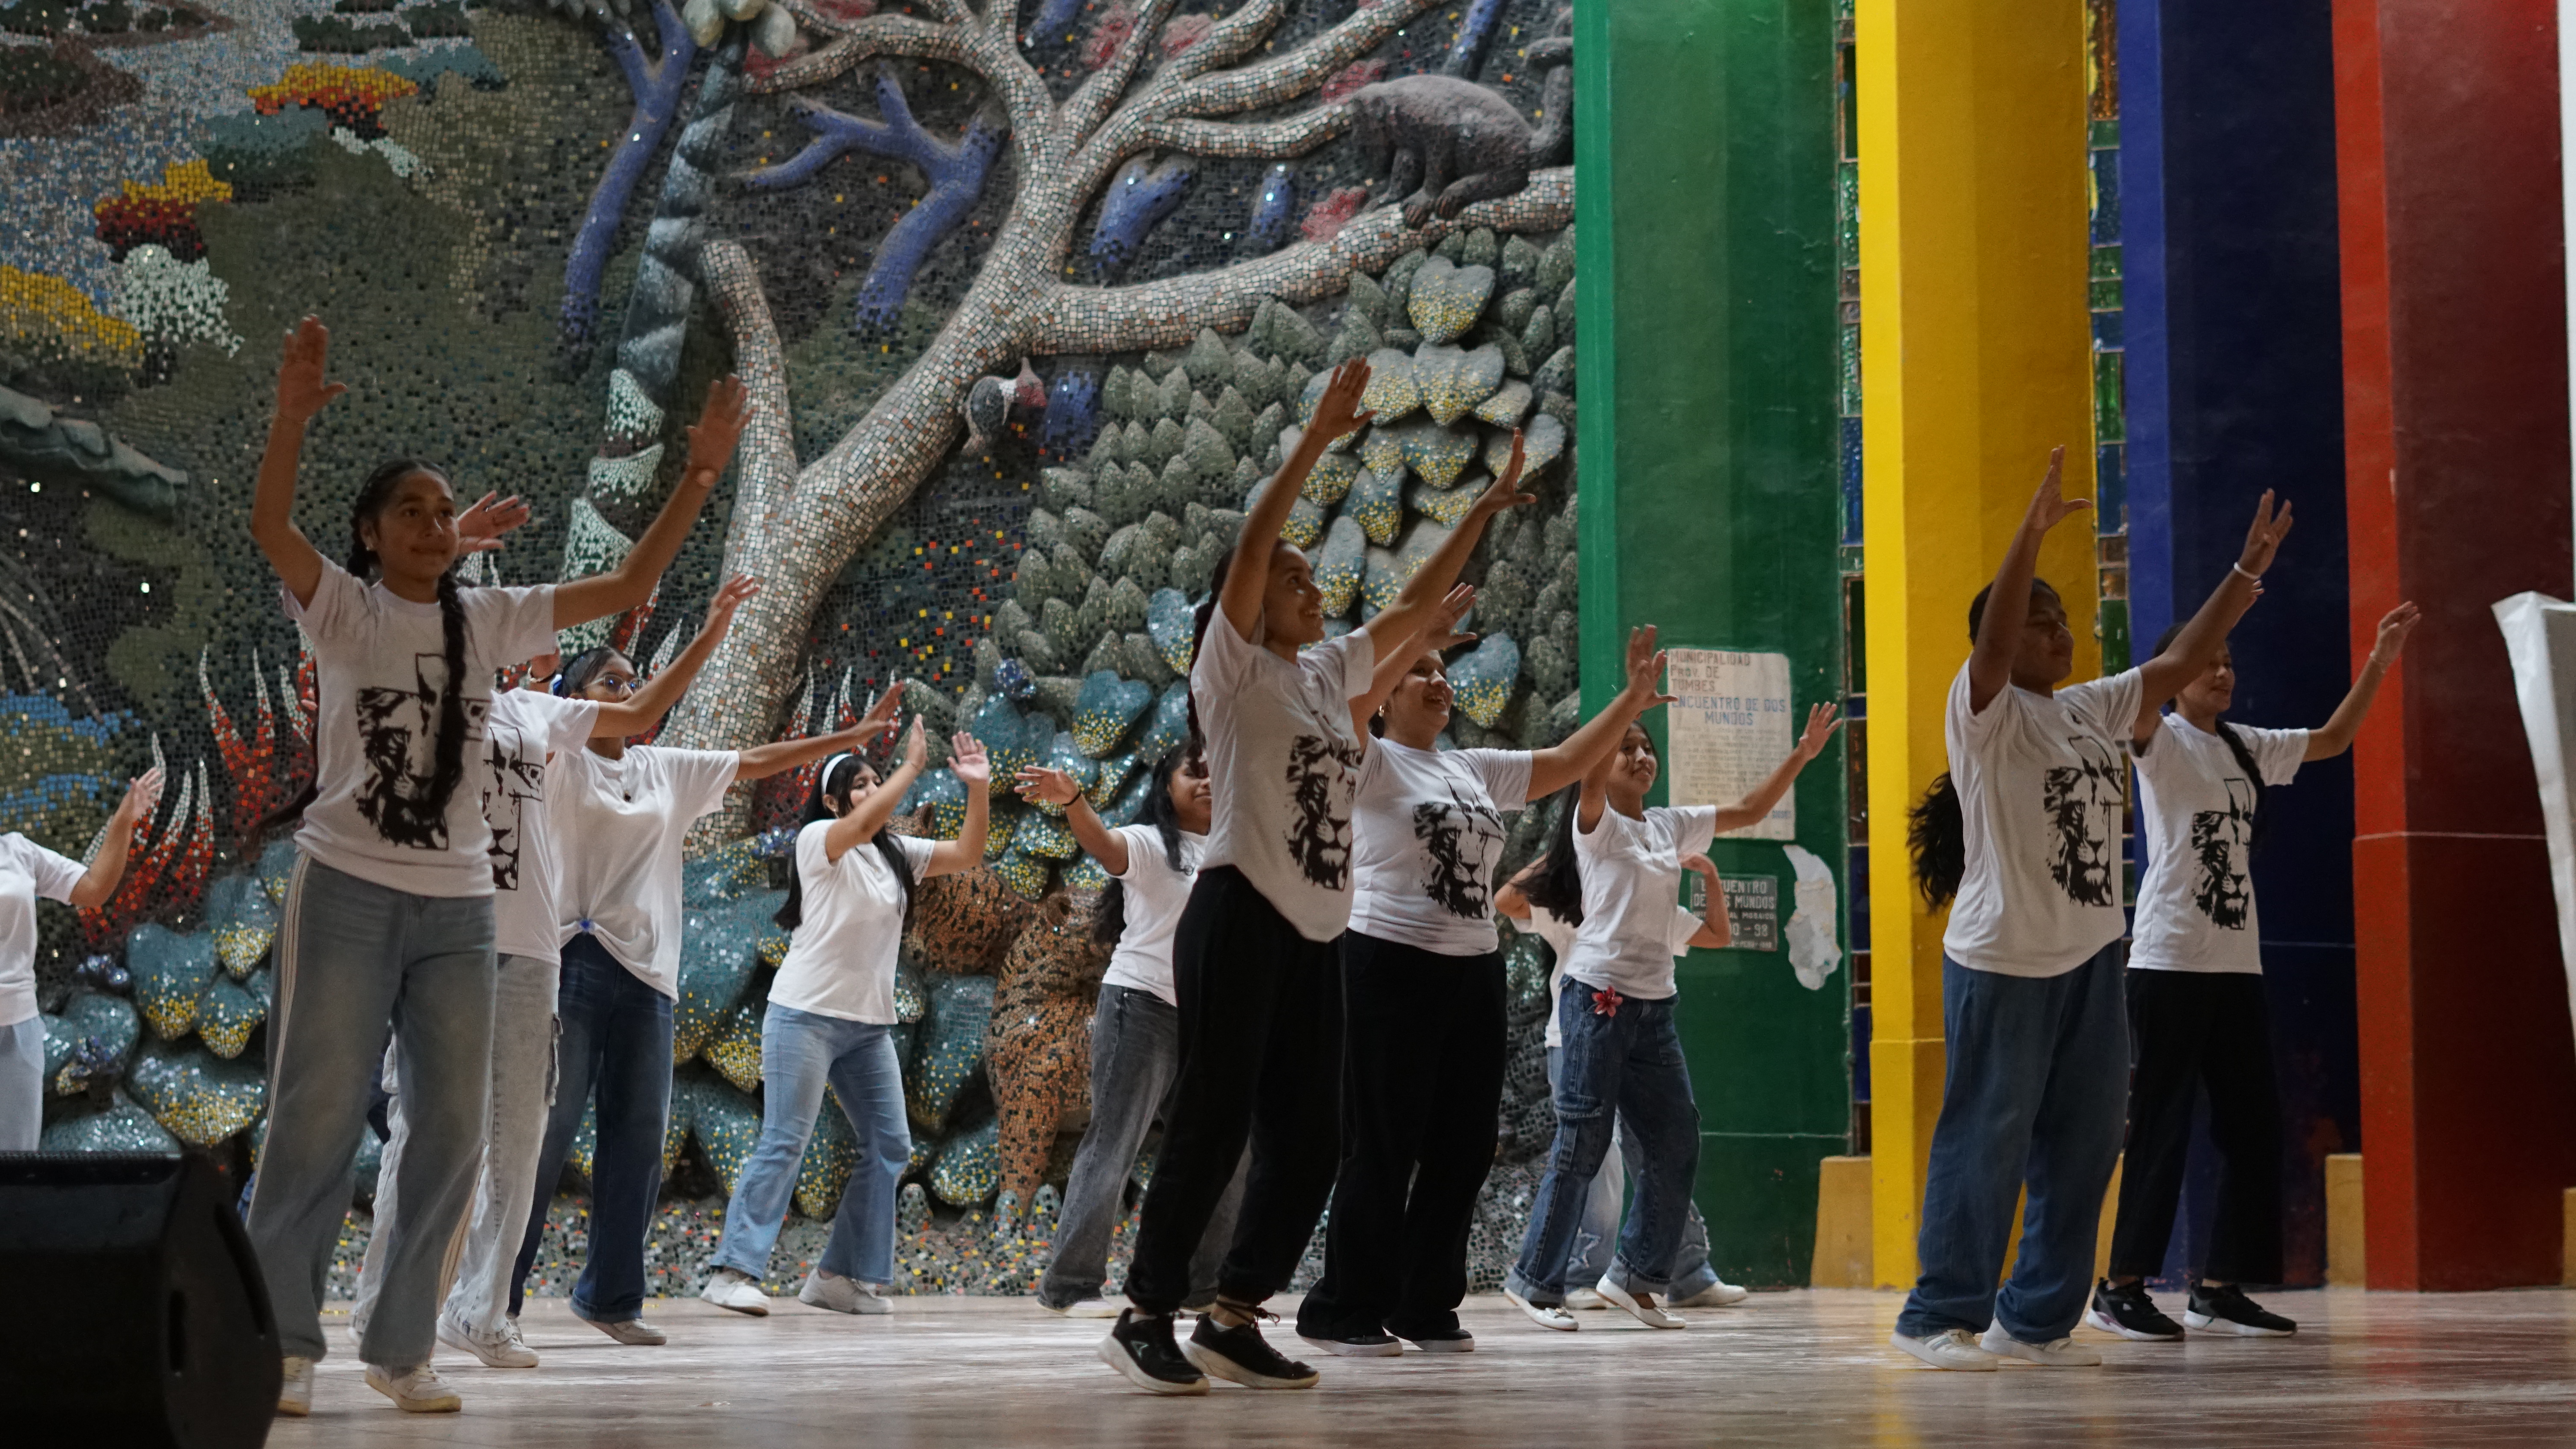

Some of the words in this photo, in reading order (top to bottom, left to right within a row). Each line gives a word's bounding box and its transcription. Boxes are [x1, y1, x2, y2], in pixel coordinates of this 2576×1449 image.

[1671, 651, 1751, 666] MUNICIPALIDAD
[1706, 665, 1719, 679] DE
[1671, 679, 1715, 692] TUMBES
[1746, 698, 1759, 712] DE
[1764, 699, 1786, 712] DOS
[1705, 711, 1754, 726] MUNDOS
[1735, 895, 1774, 909] MUNDOS
